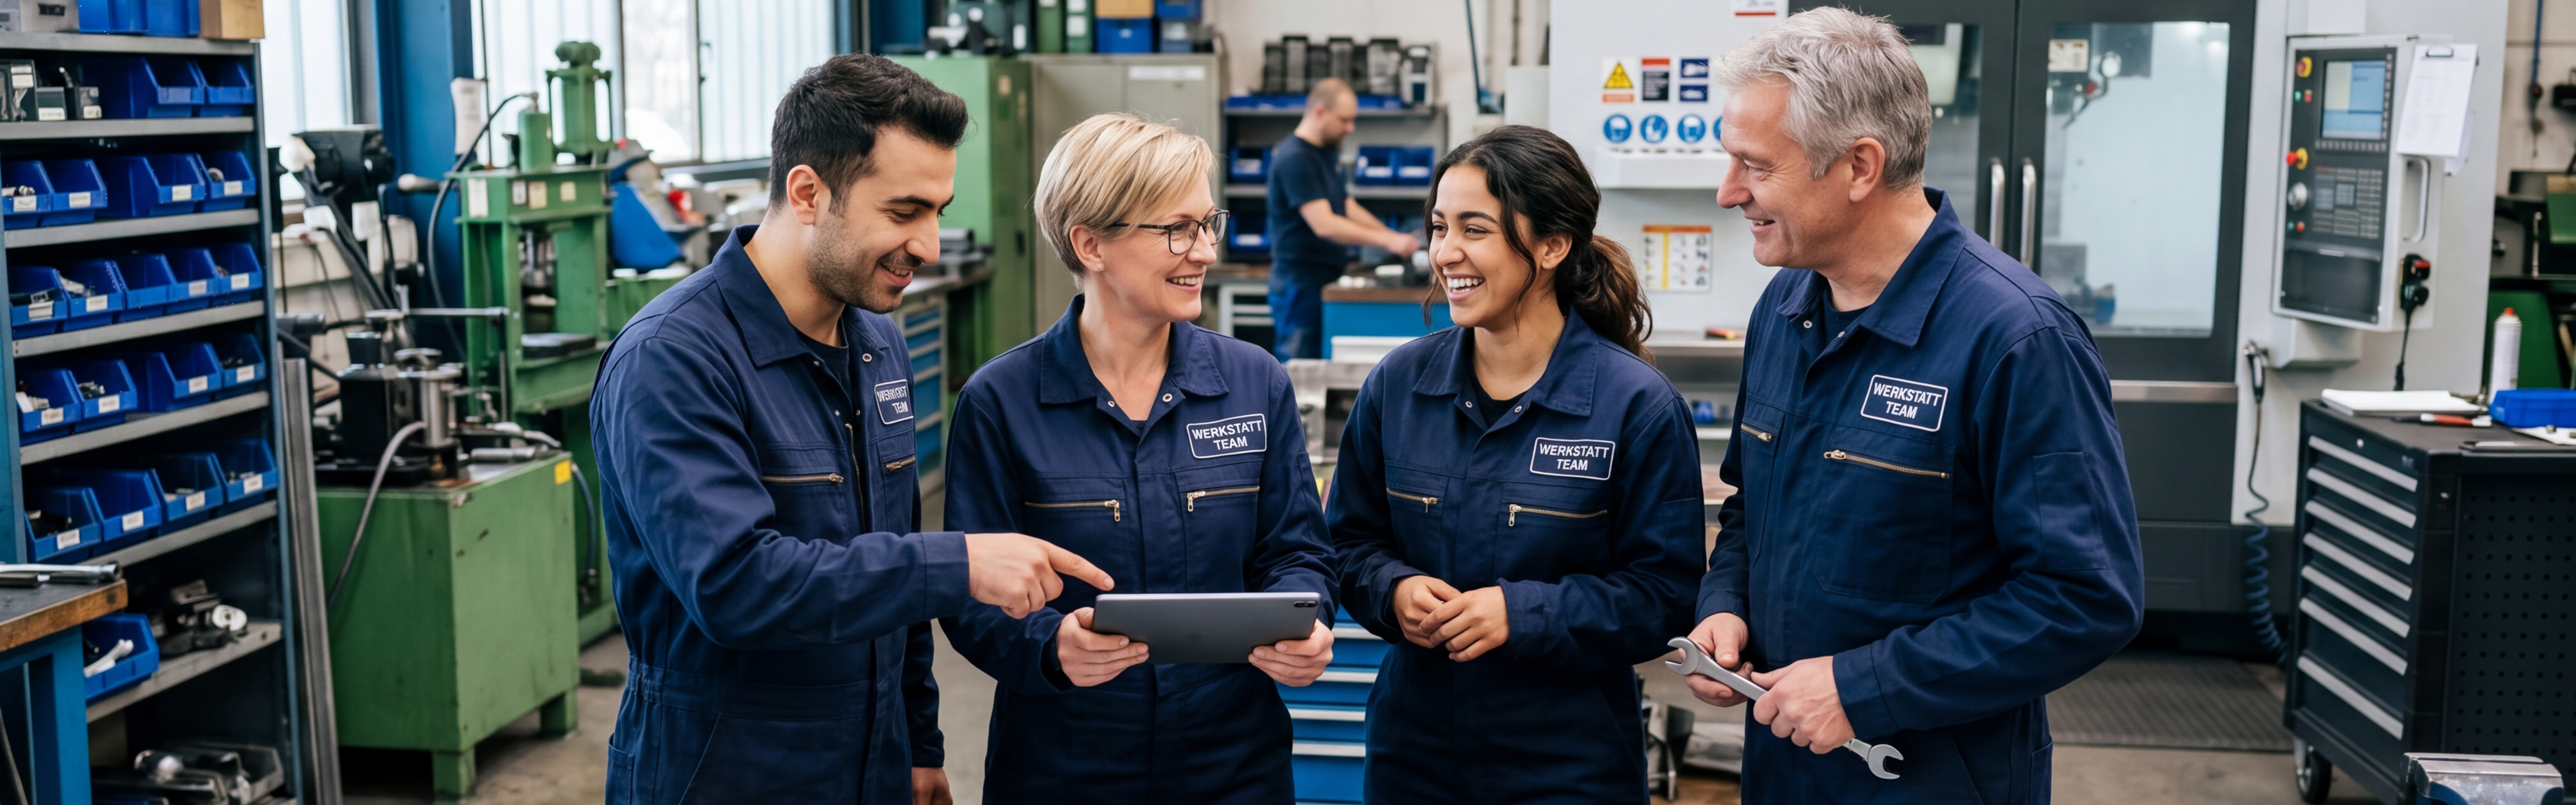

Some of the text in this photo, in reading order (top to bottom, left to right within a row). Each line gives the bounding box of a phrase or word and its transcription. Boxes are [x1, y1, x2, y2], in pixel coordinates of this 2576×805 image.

[1873, 382, 1942, 406] WERKSTATT
[1886, 401, 1918, 419] TEAM
[1192, 420, 1262, 439] WERKSTATT
[1213, 436, 1248, 450] TEAM
[1539, 443, 1610, 458] WERKSTATT
[1557, 459, 1588, 471] TEAM
